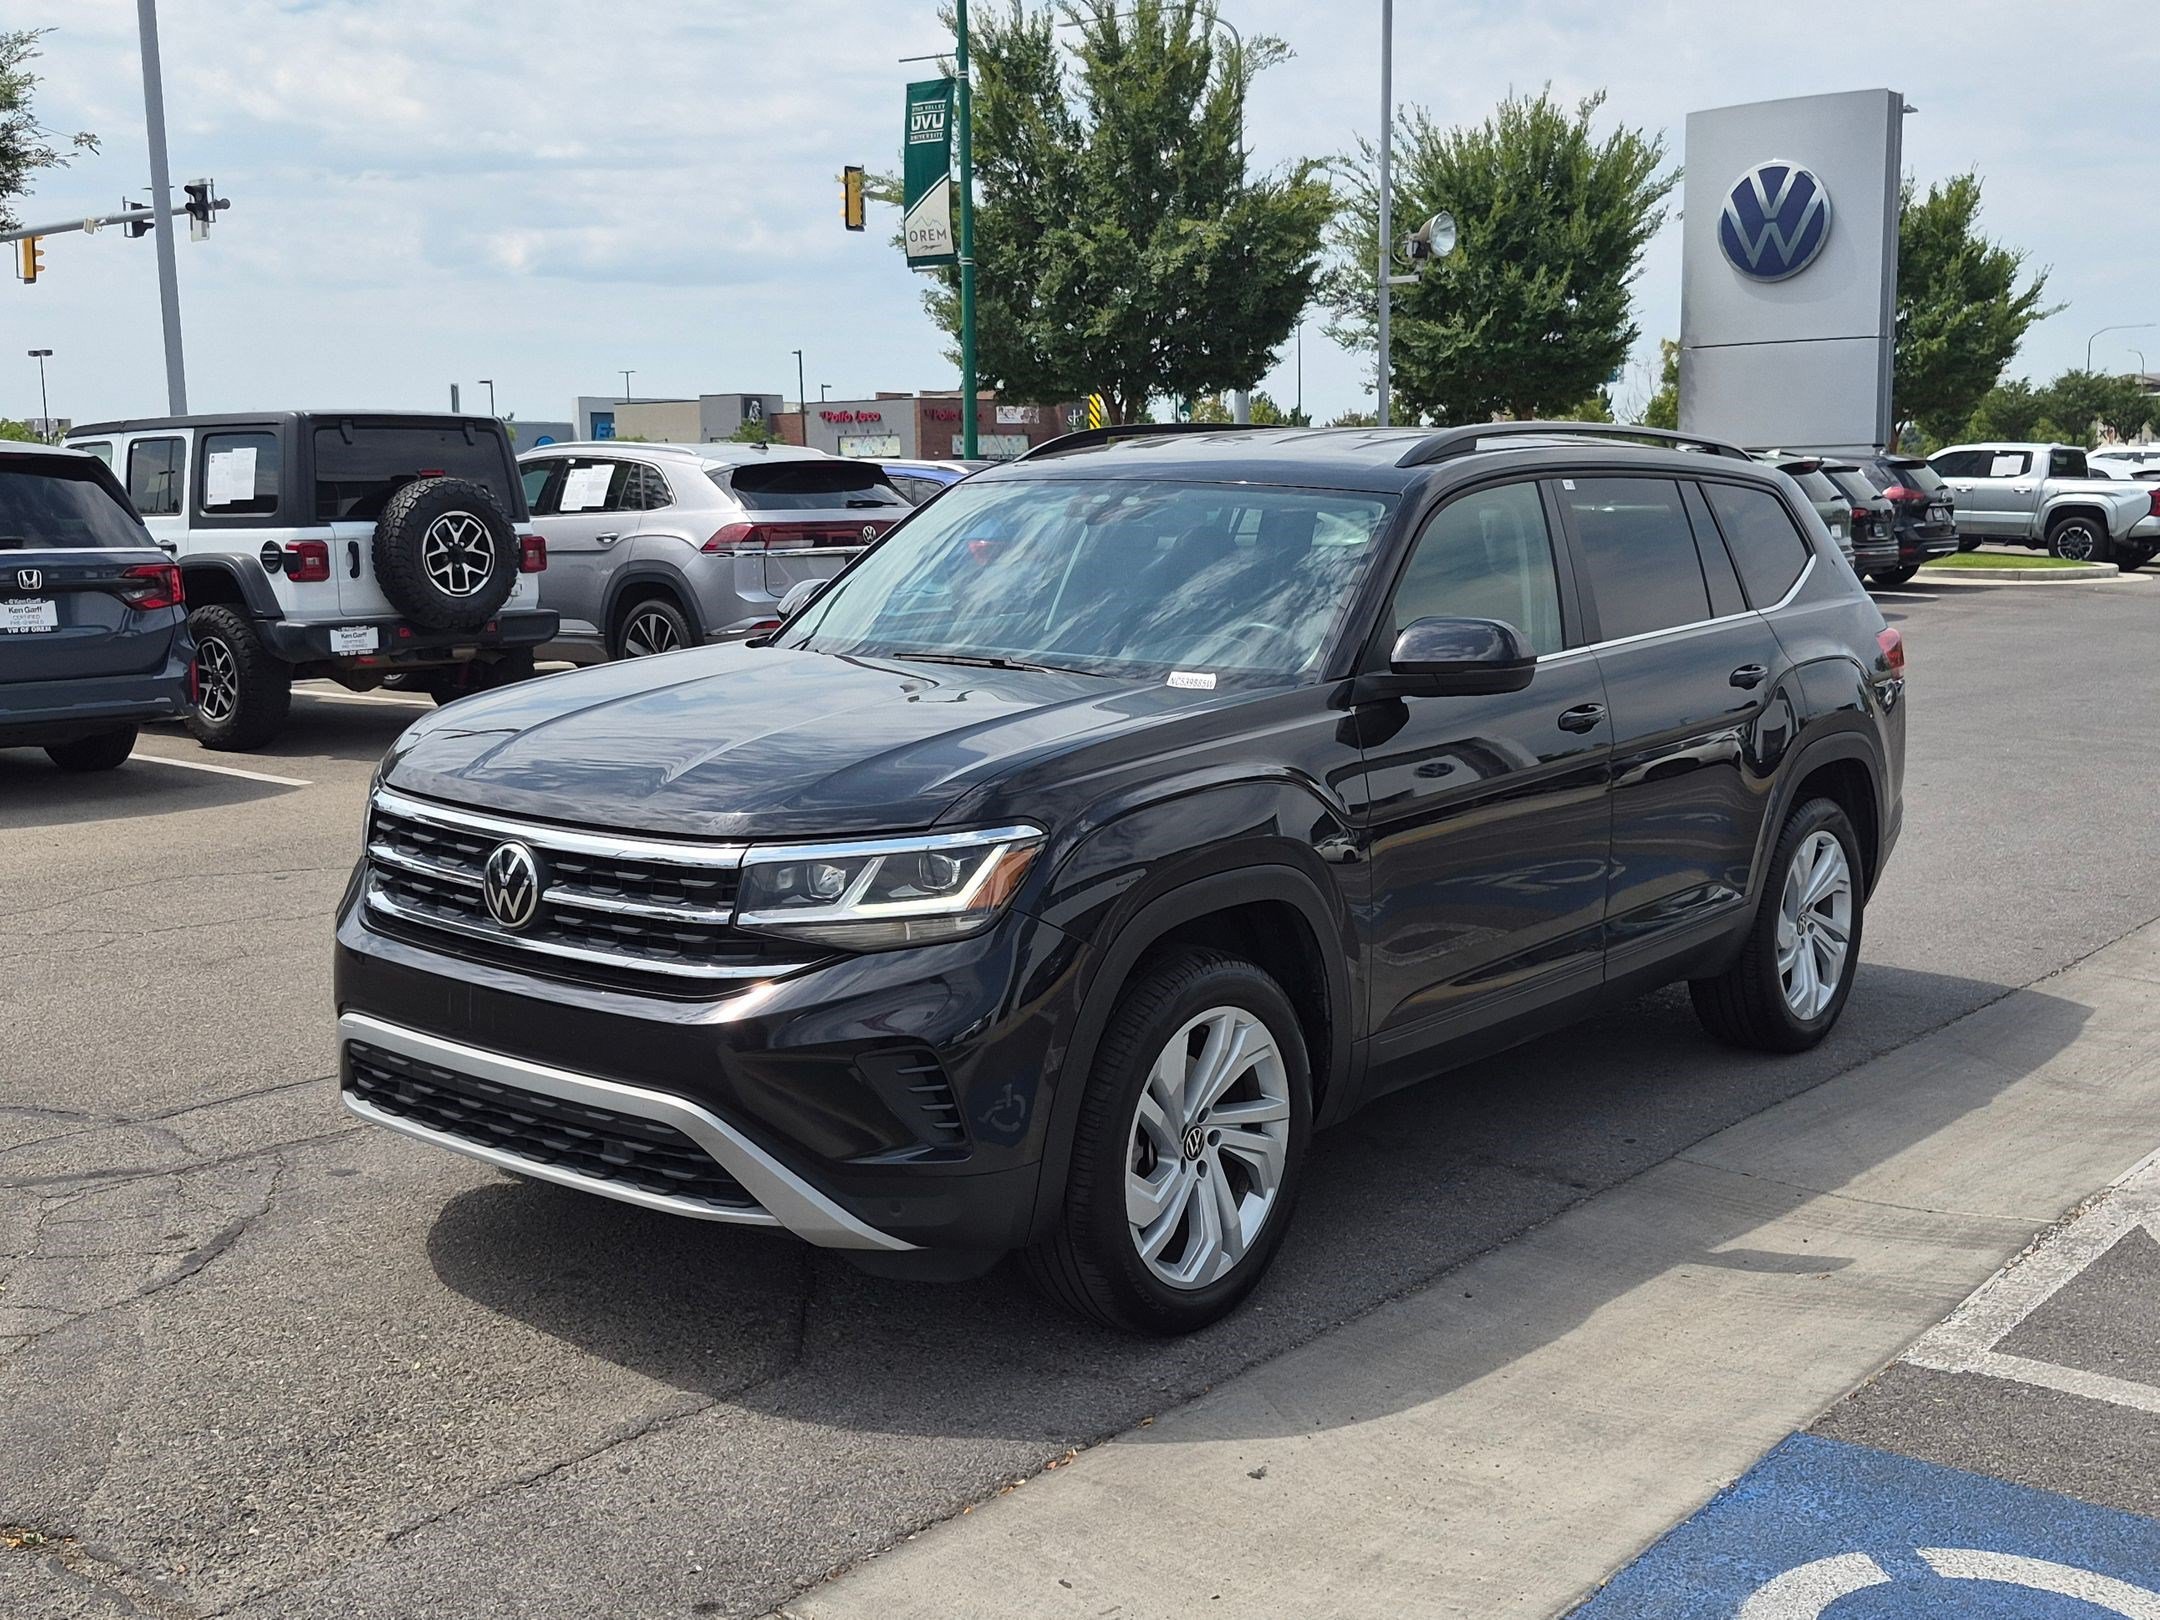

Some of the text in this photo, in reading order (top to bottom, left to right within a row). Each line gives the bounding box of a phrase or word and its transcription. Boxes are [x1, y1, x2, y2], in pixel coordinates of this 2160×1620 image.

[911, 113, 945, 131] UVU
[910, 132, 943, 140] UNIVERSITY
[909, 227, 948, 243] OREM
[484, 840, 537, 928] VW
